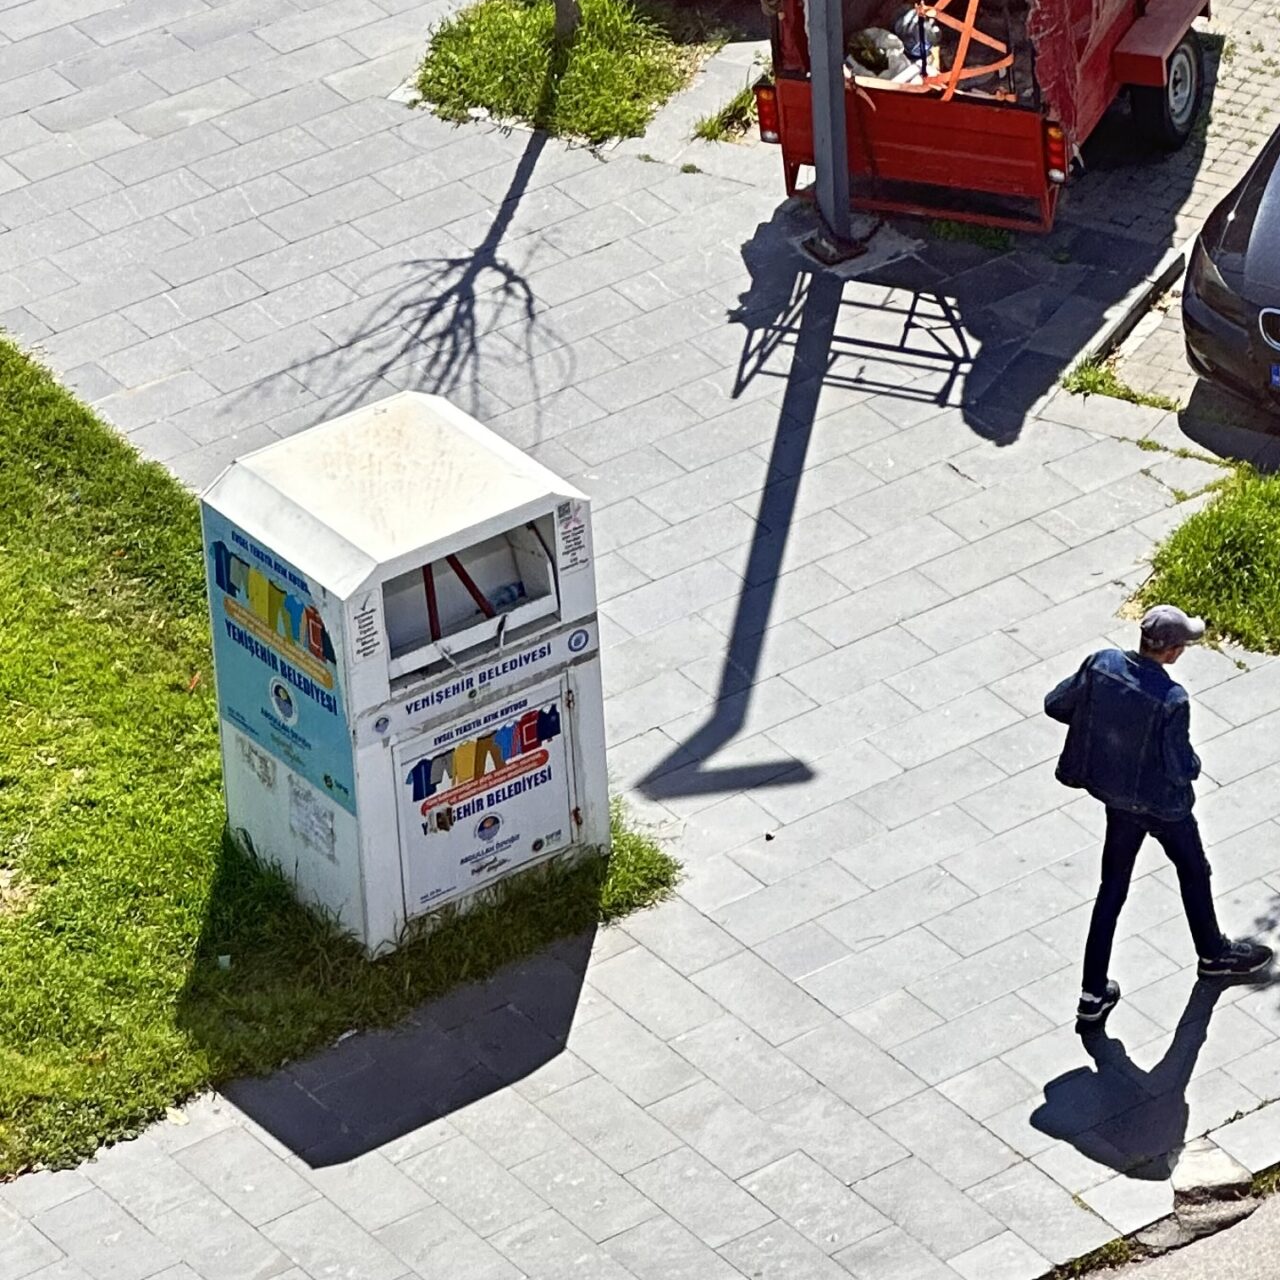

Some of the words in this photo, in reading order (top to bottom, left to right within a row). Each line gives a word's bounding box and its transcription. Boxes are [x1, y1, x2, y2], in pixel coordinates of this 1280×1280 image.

[225, 618, 279, 672] YENİŞEHİR
[280, 659, 338, 717] BELEDİYESİ
[405, 676, 474, 716] YENİŞEHİR
[478, 642, 552, 685] BELEDİYESİ
[486, 764, 552, 808] BELEDİYESİ
